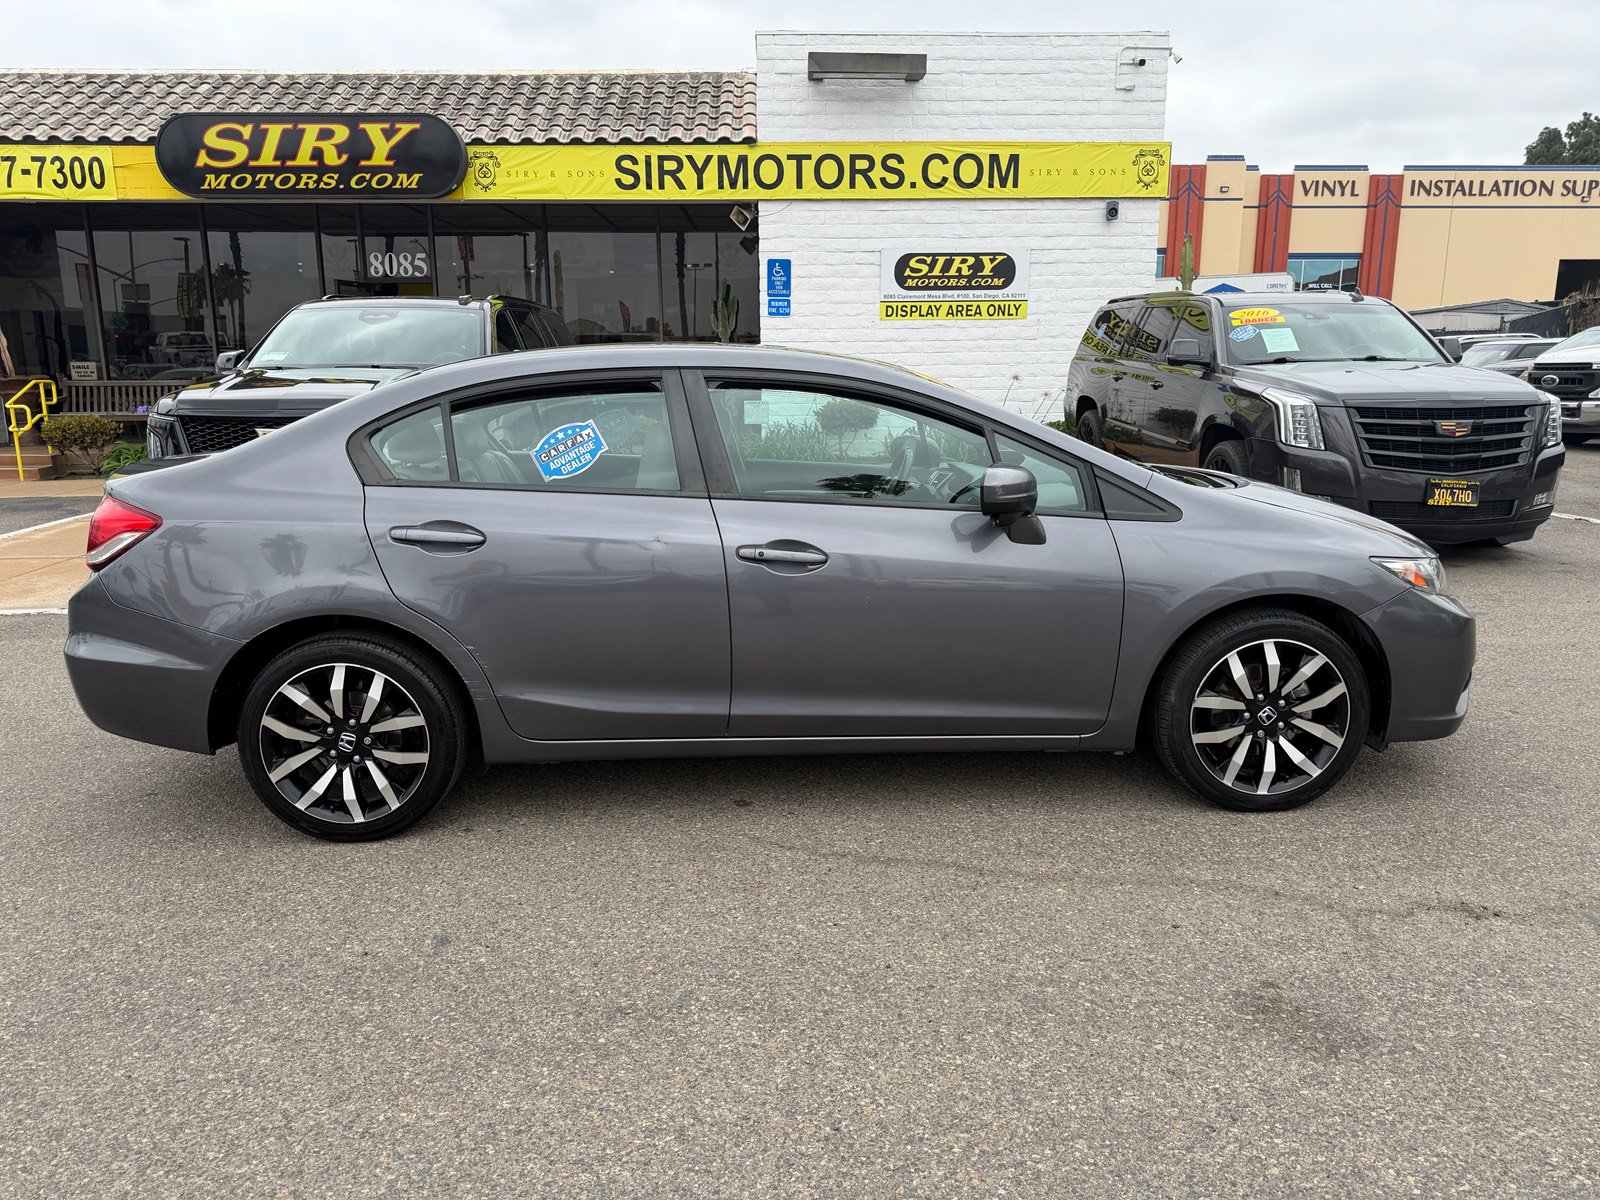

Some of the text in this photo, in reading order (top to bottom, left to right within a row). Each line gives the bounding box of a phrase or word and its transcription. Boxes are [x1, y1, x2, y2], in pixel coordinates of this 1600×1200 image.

[194, 121, 422, 168] SIRY
[0, 155, 106, 189] 7-7300
[200, 173, 424, 190] MOTORS.COM
[506, 170, 606, 178] SIRY & SONS
[614, 153, 1020, 191] SIRYMOTORS.COM
[1029, 168, 1127, 176] SIRY & SONS
[1300, 179, 1600, 198] VINYL INSTALLATION SUP
[369, 252, 428, 277] 8085
[903, 255, 1008, 277] SIRY
[904, 277, 1006, 287] MOTORS.COM
[885, 304, 1022, 318] DISPLAY AREA ONLY
[1239, 310, 1269, 318] 2016
[1239, 317, 1278, 325] LOADED
[540, 430, 593, 462] CARFAX
[549, 441, 596, 471] ADVANTAGE
[561, 453, 593, 475] DEALER
